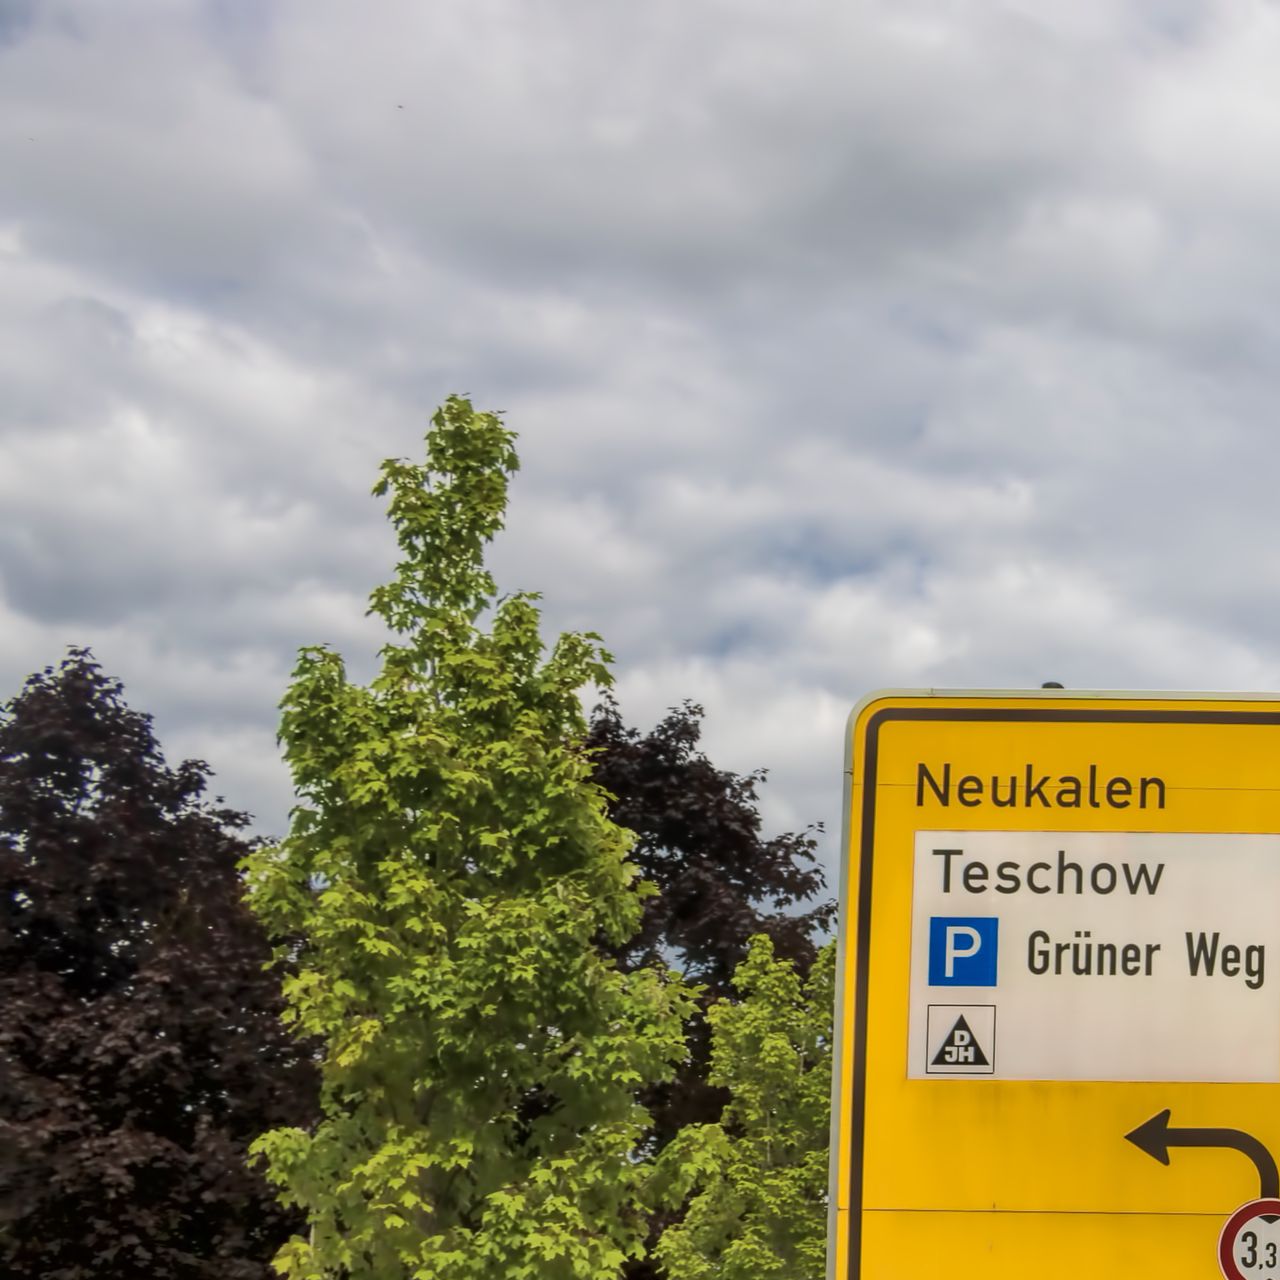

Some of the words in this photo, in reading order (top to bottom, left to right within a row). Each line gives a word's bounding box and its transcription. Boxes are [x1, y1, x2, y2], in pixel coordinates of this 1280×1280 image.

[916, 763, 1166, 809] Neukalen
[932, 849, 1165, 895] Teschow
[944, 925, 982, 978] P
[1027, 930, 1161, 976] Grüner
[1185, 931, 1265, 990] Weg
[954, 1029, 971, 1046] D
